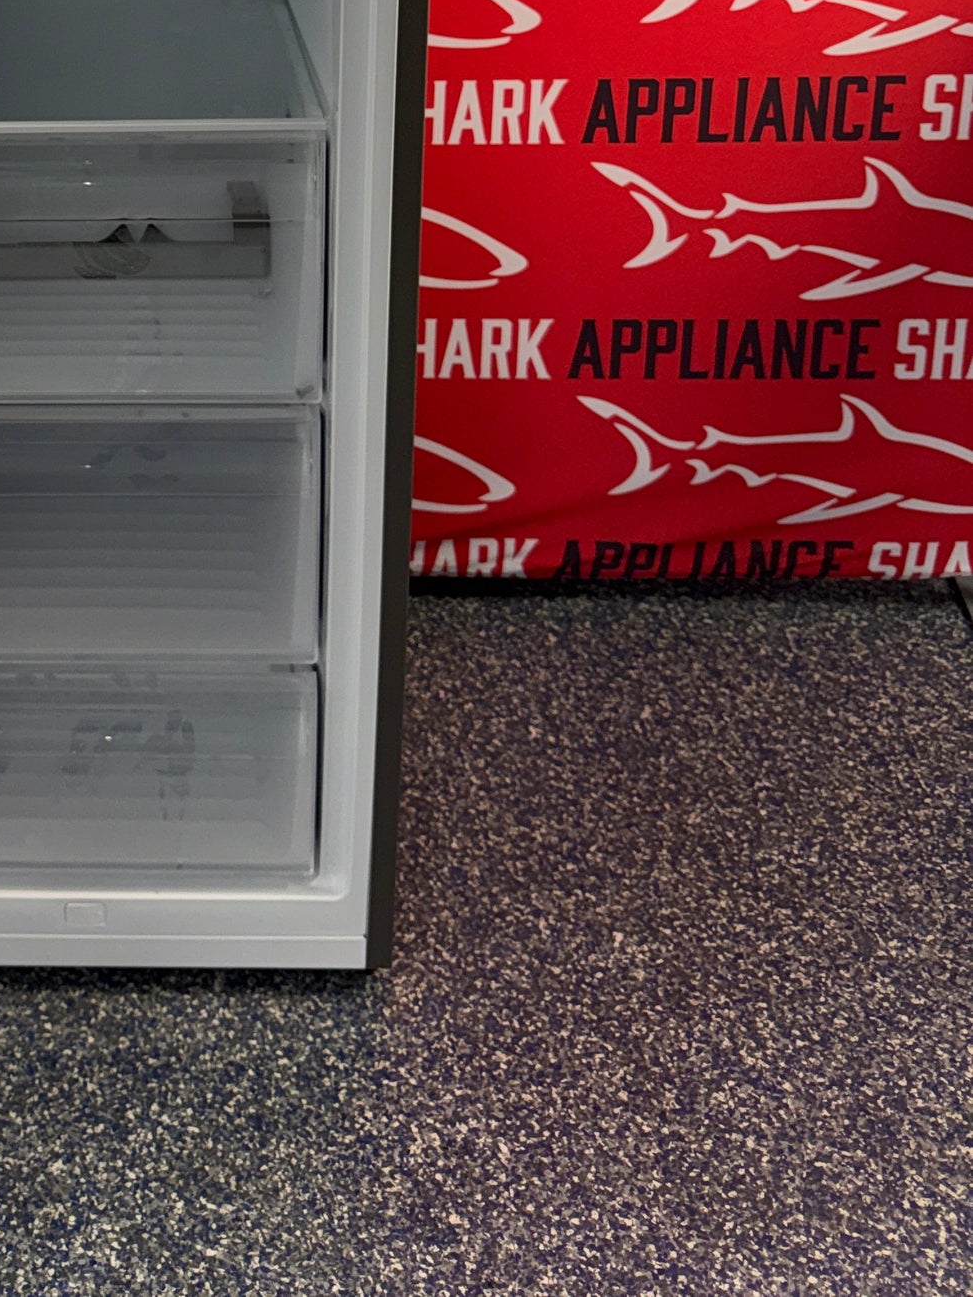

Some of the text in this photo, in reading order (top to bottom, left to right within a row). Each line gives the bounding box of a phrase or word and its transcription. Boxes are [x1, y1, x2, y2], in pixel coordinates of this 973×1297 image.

[581, 75, 907, 143] APPLIANCE
[567, 318, 881, 380] APPLIANCE
[894, 318, 973, 380] SH
